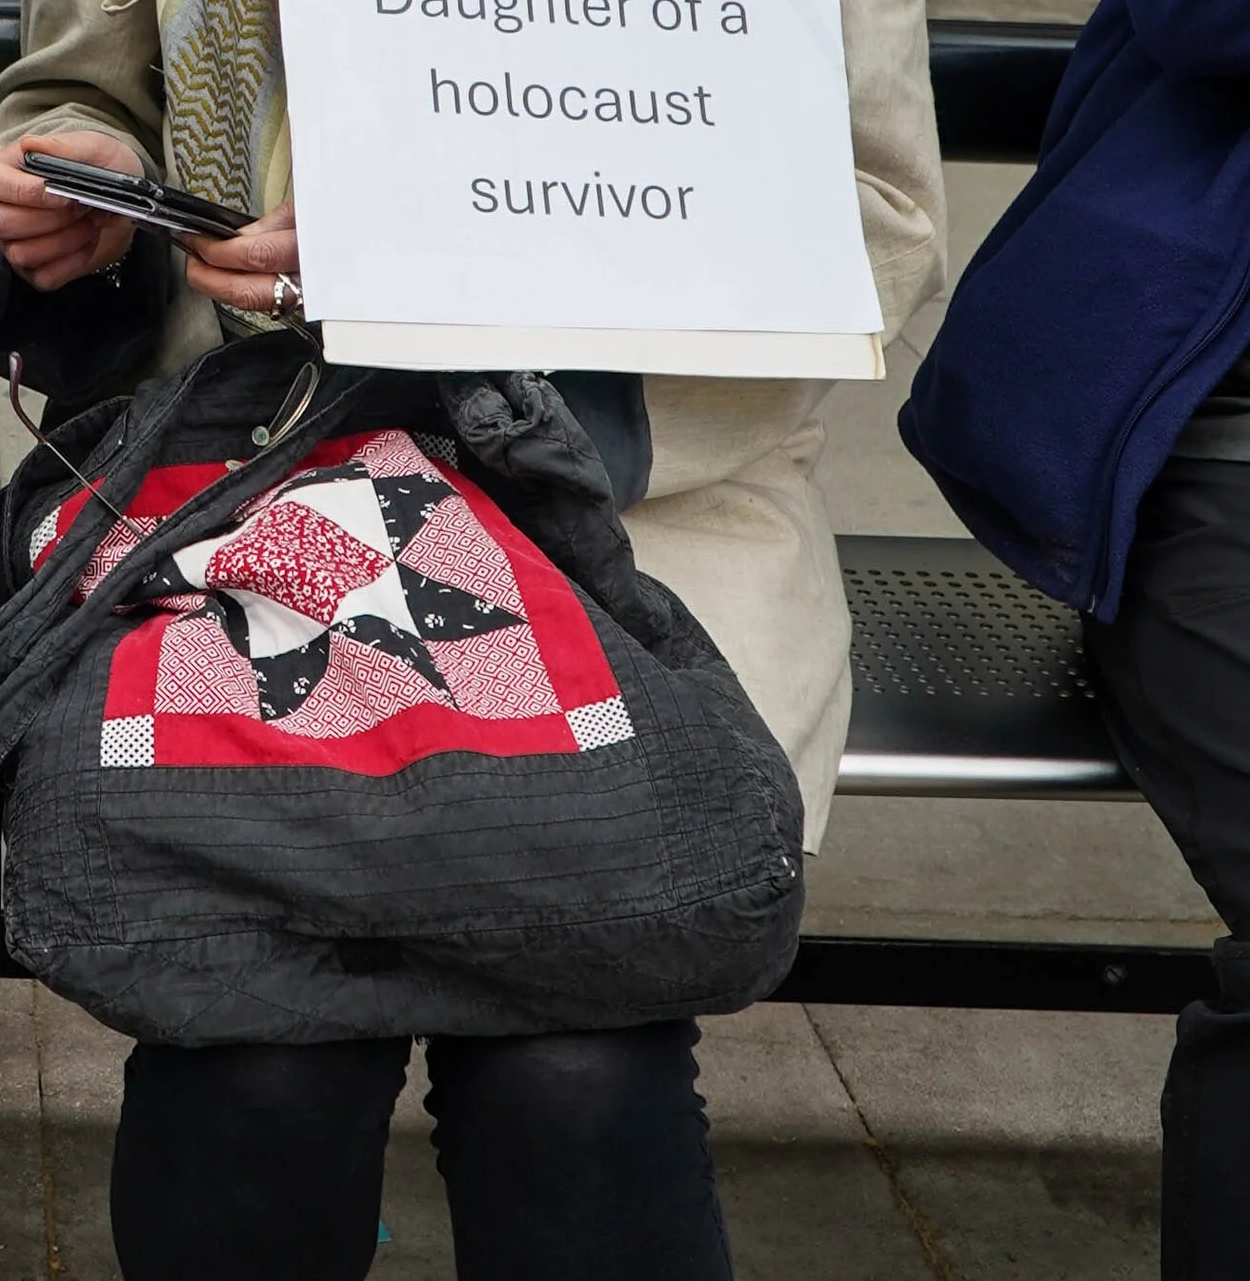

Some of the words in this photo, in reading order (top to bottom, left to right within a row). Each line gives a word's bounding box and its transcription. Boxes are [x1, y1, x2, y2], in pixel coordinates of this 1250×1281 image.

[720, 0, 749, 35] a
[430, 67, 716, 127] holocaust
[470, 170, 695, 221] survivor
